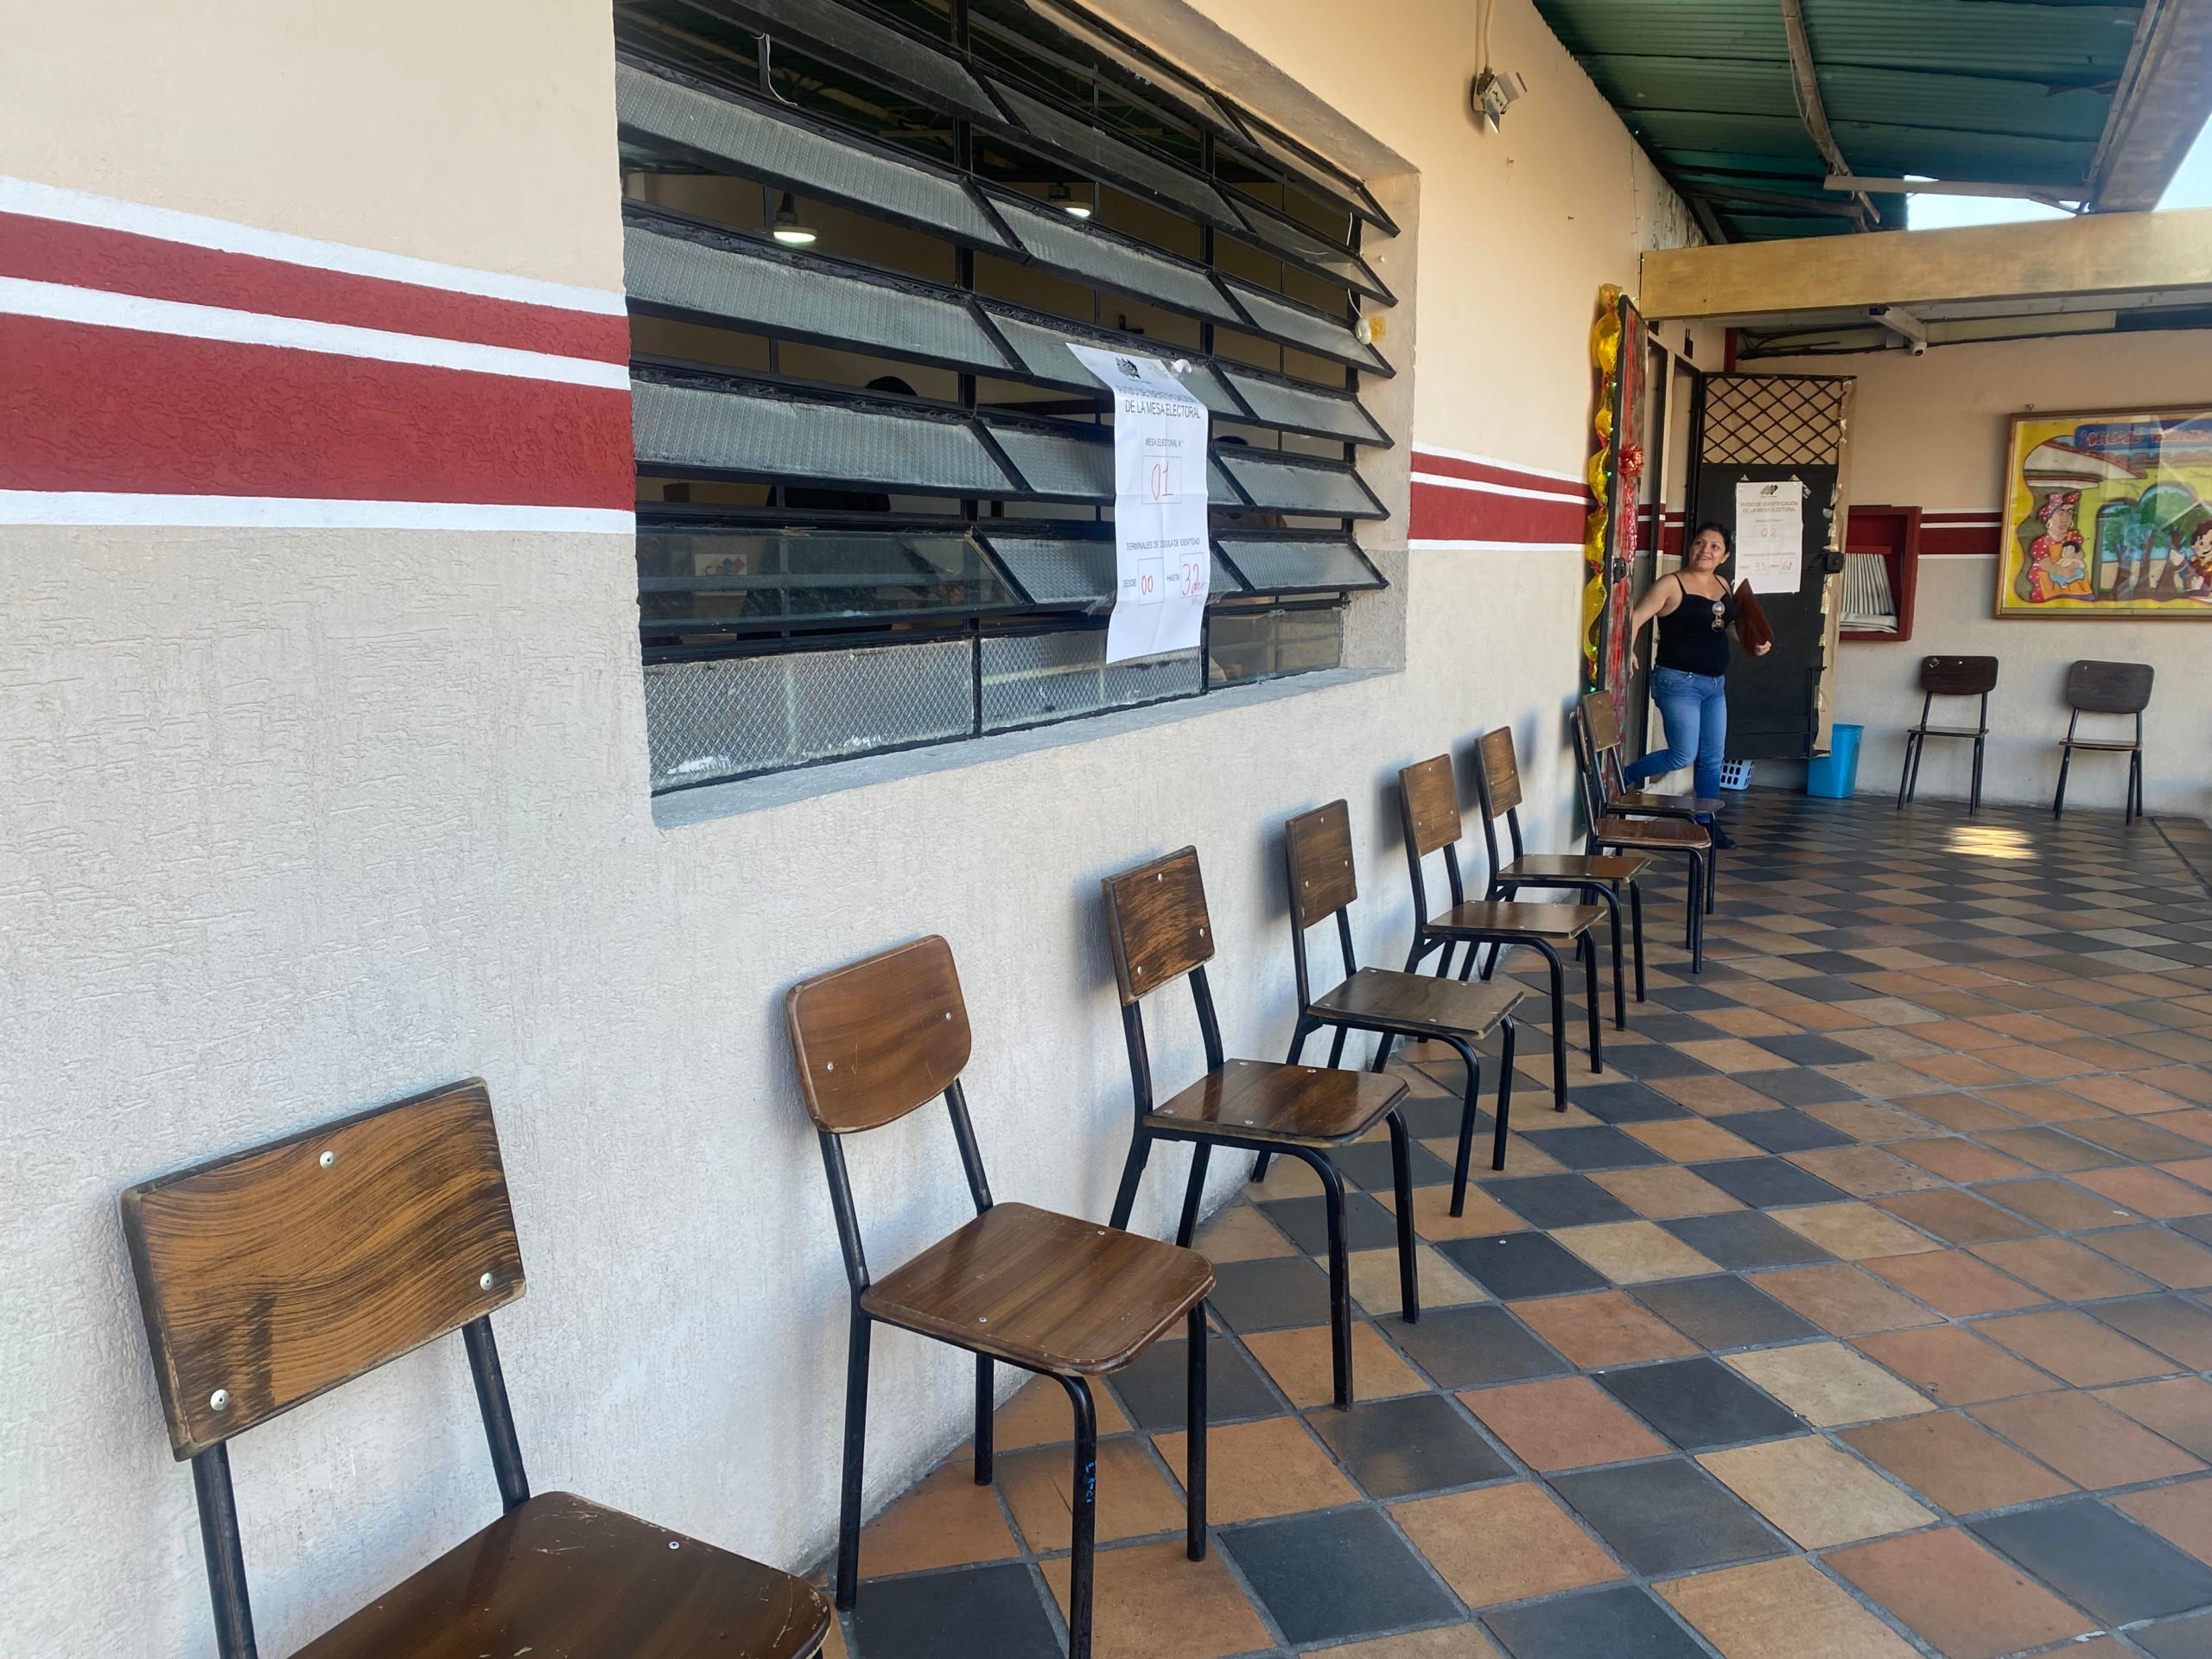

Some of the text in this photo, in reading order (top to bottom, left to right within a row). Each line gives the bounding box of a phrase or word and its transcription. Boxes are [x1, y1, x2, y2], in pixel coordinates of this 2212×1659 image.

[1125, 399, 1201, 419] DE LA MESA ELECTORAL
[1145, 437, 1157, 447] MESA
[1156, 437, 1178, 448] ELECTORAL
[1151, 461, 1173, 500] 01
[1126, 540, 1153, 551] TERMINALES
[1154, 540, 1160, 549] DE
[1173, 538, 1179, 547] DE
[1179, 537, 1200, 546] IDENTIDAD
[1122, 578, 1137, 588] DESDE
[1141, 575, 1154, 595] 00
[1166, 573, 1179, 582] HASTA
